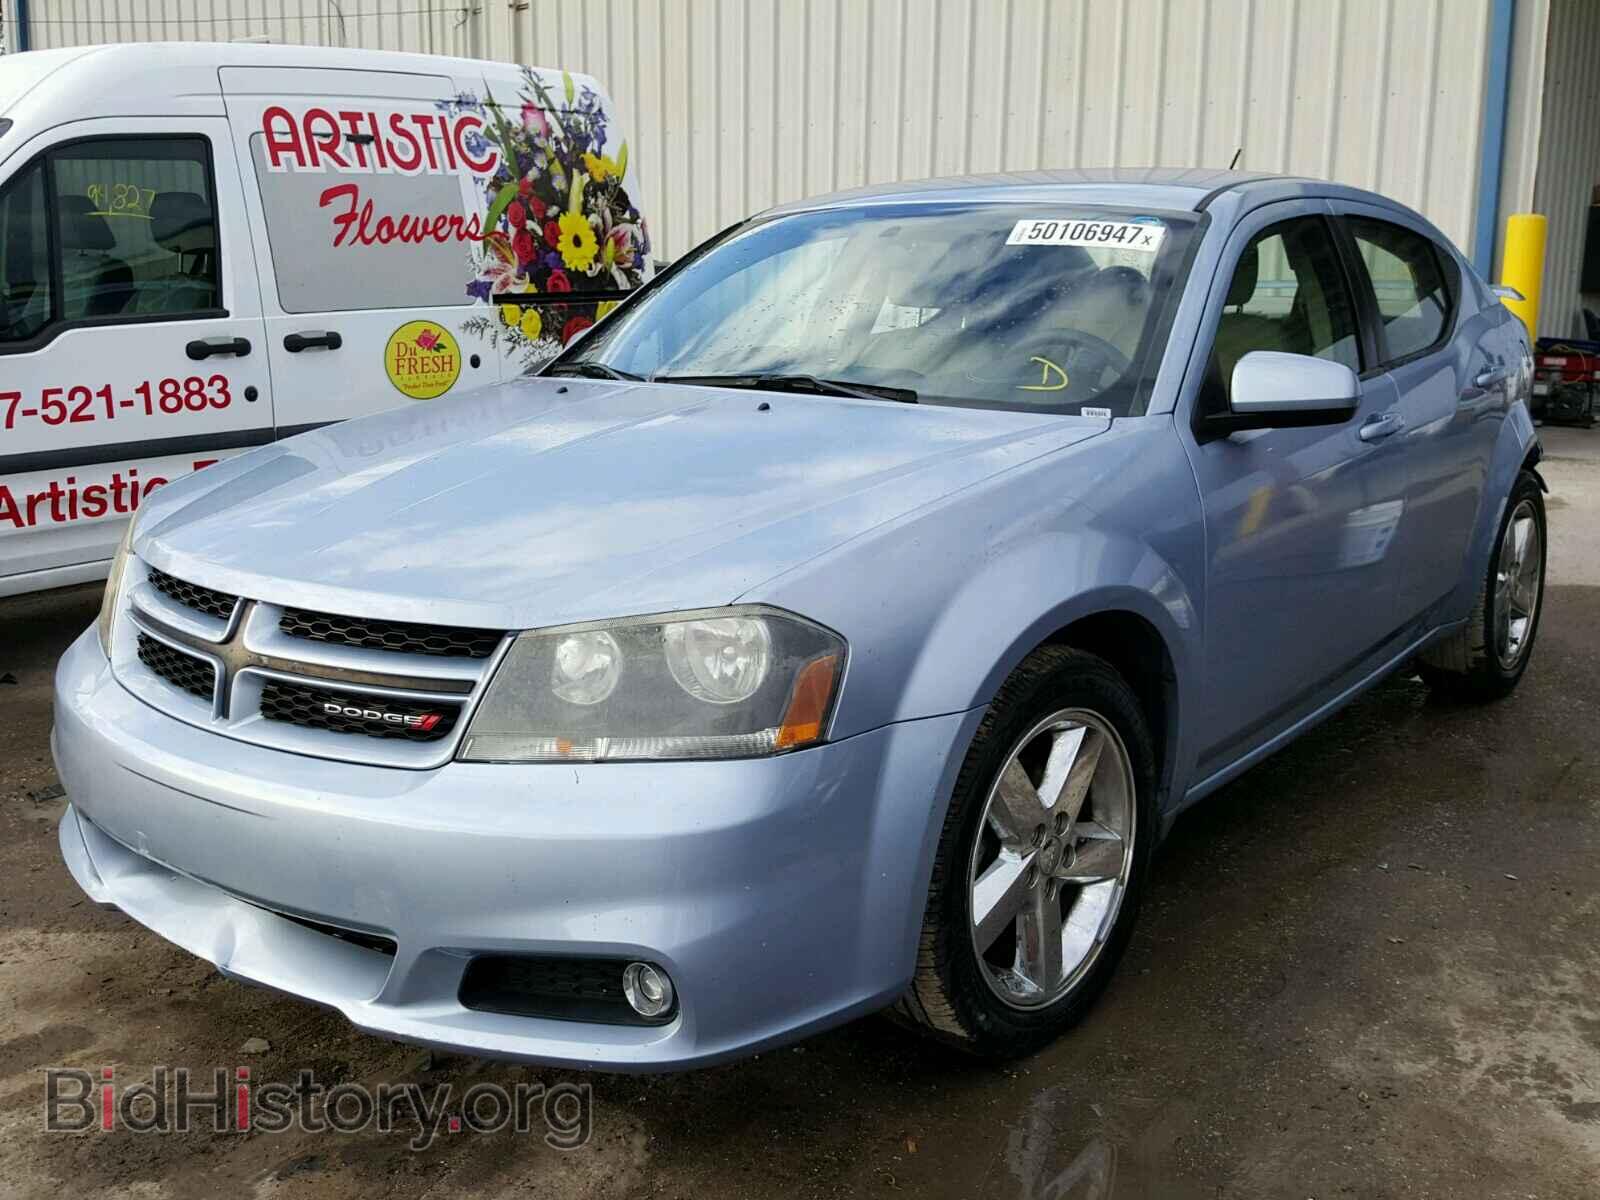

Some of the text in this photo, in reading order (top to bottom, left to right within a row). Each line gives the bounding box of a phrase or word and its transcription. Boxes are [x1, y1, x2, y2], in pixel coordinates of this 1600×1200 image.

[262, 106, 498, 174] ARTISTIC
[318, 183, 492, 248] Flowers
[1028, 222, 1144, 245] 50106947
[395, 341, 417, 358] Du
[395, 353, 454, 376] FRESH
[0, 374, 232, 430] 7-521-1883
[323, 703, 424, 726] DODGE
